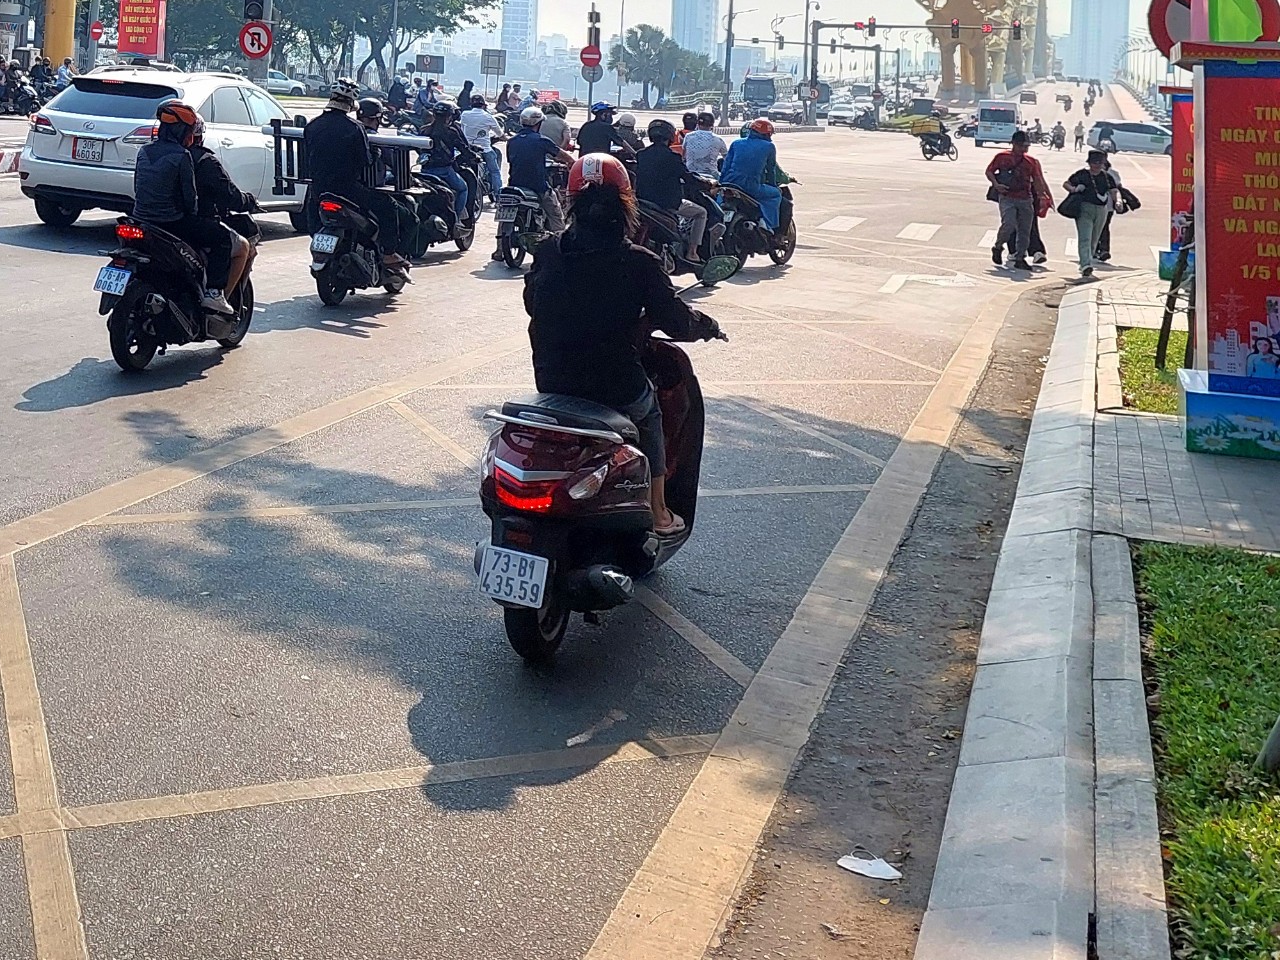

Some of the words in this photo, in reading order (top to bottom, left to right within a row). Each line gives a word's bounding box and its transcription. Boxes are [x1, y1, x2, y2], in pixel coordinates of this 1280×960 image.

[83, 140, 96, 150] 30F
[1253, 220, 1280, 235] NG
[1240, 264, 1271, 280] 1/5
[492, 551, 536, 580] 73-B1
[483, 572, 540, 603] 435.59
